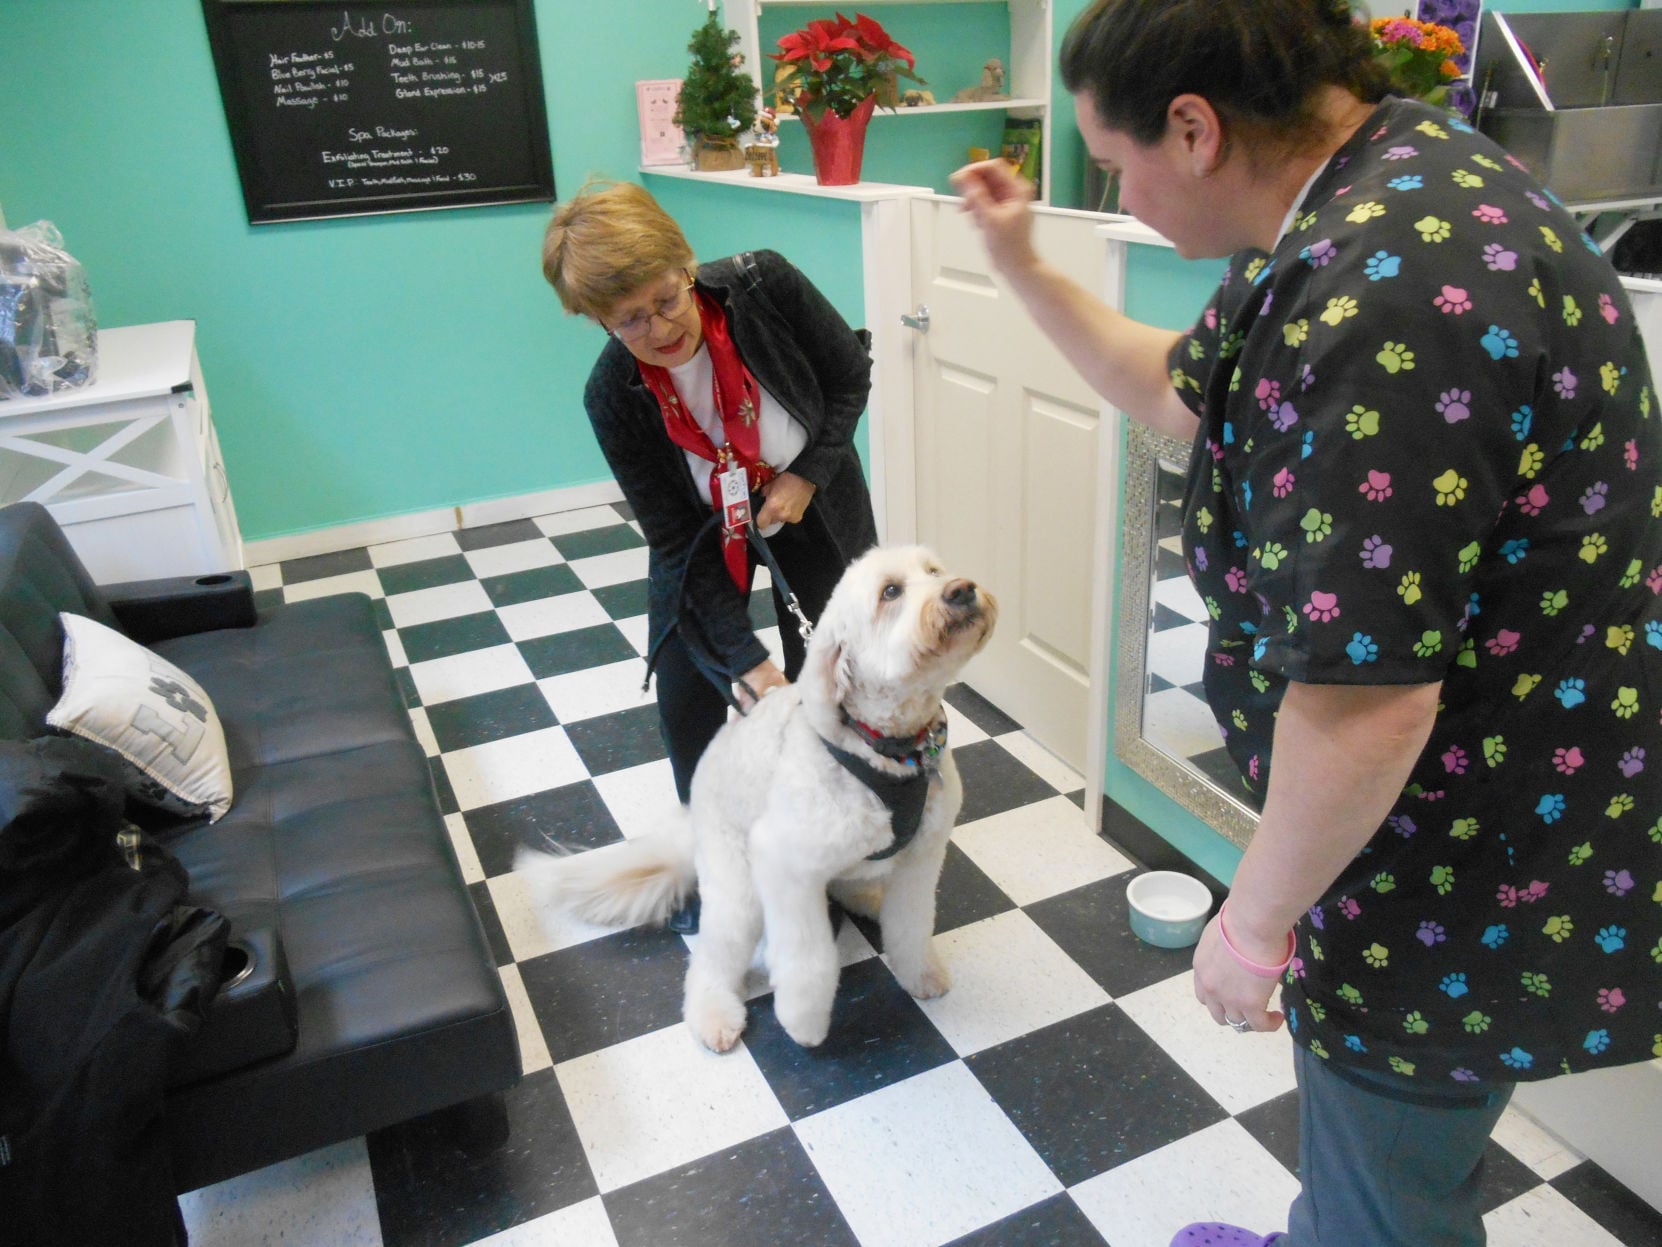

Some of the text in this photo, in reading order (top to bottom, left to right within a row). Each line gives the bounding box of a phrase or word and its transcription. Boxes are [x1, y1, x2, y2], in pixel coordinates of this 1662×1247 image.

[331, 11, 412, 41] Add On:
[388, 44, 412, 55] Deep
[430, 42, 452, 50] Clean
[269, 54, 289, 67] Hair
[412, 56, 433, 66] Bath
[390, 72, 419, 83] Teeth
[422, 72, 461, 83] Brushing
[274, 84, 292, 94] Nail
[335, 80, 349, 88] $10
[395, 88, 421, 98] Gland
[424, 87, 466, 98] Expression
[276, 96, 318, 108] Massage
[348, 128, 373, 142] Spa
[372, 148, 413, 159] Treatment
[458, 173, 477, 181] $30
